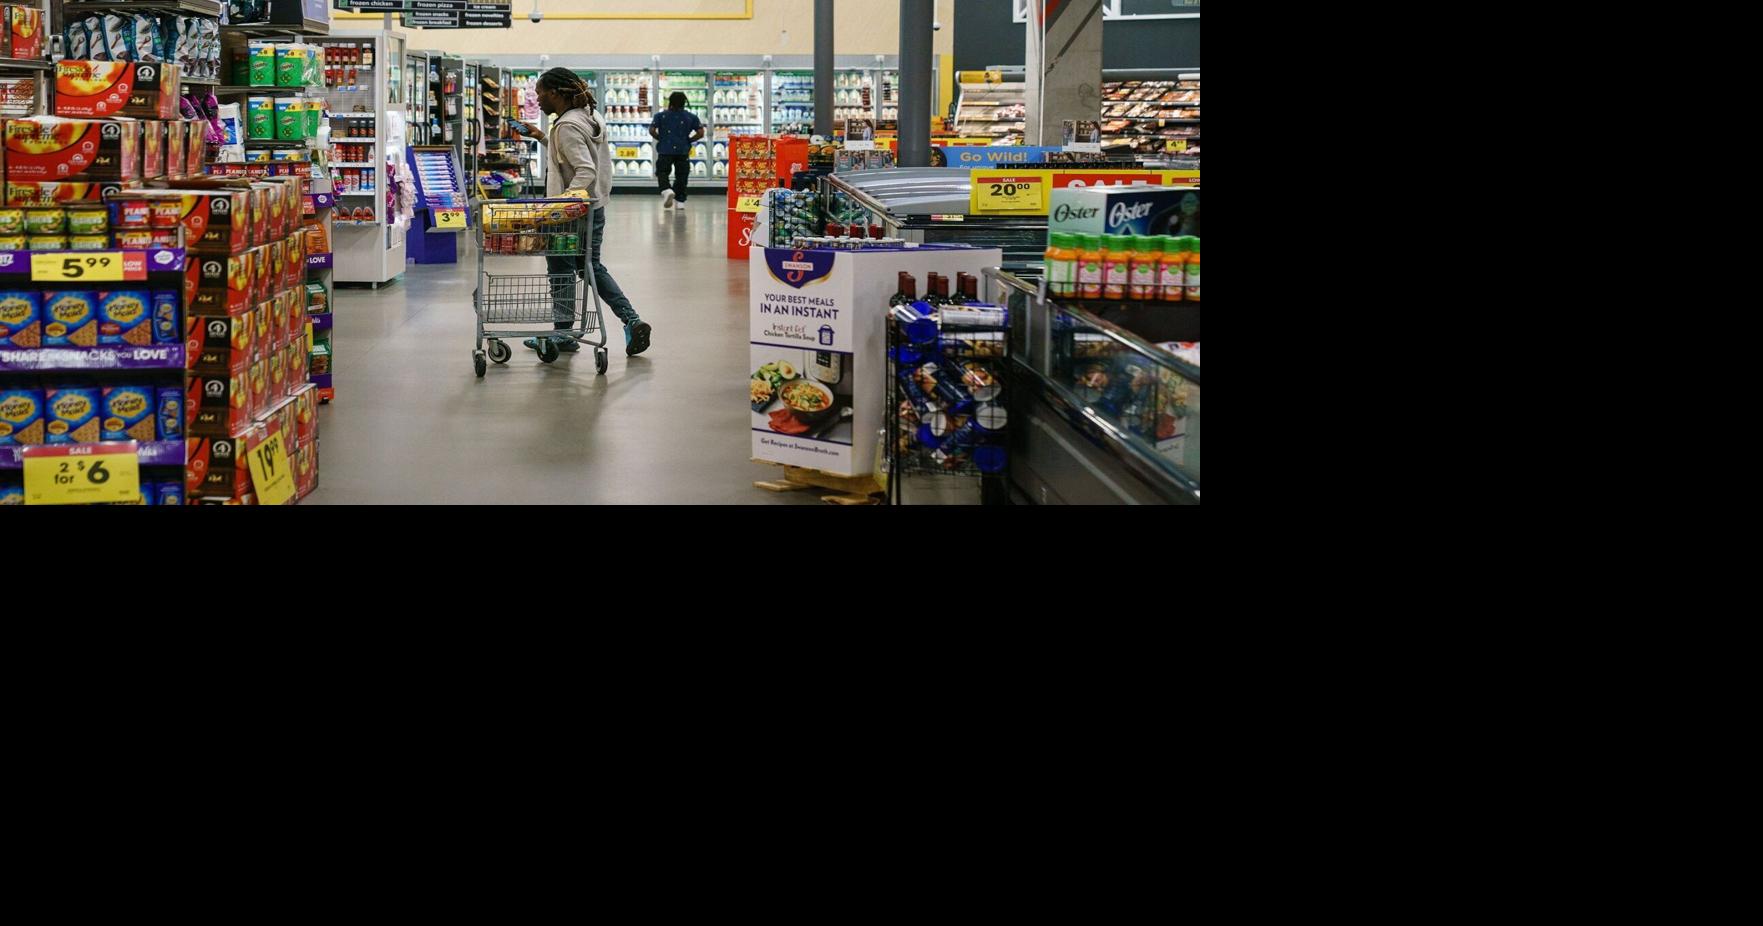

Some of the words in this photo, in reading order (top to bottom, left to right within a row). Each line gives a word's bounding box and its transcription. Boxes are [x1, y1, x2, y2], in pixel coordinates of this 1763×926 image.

[960, 152, 982, 162] Go
[987, 151, 1028, 163] Wild!
[1054, 203, 1099, 223] Oster
[1108, 201, 1153, 228] Oster
[765, 293, 787, 303] YOUR
[788, 295, 807, 304] BEST
[809, 297, 835, 307] MEALS
[760, 303, 772, 314] IN
[774, 304, 789, 315] AN
[792, 306, 840, 320] INSTANT
[2, 351, 45, 363] SHARE
[61, 350, 116, 361] SNACKS
[133, 349, 167, 360] LOVE
[69, 447, 92, 455] SALE
[60, 462, 69, 473] 2
[54, 474, 74, 485] for
